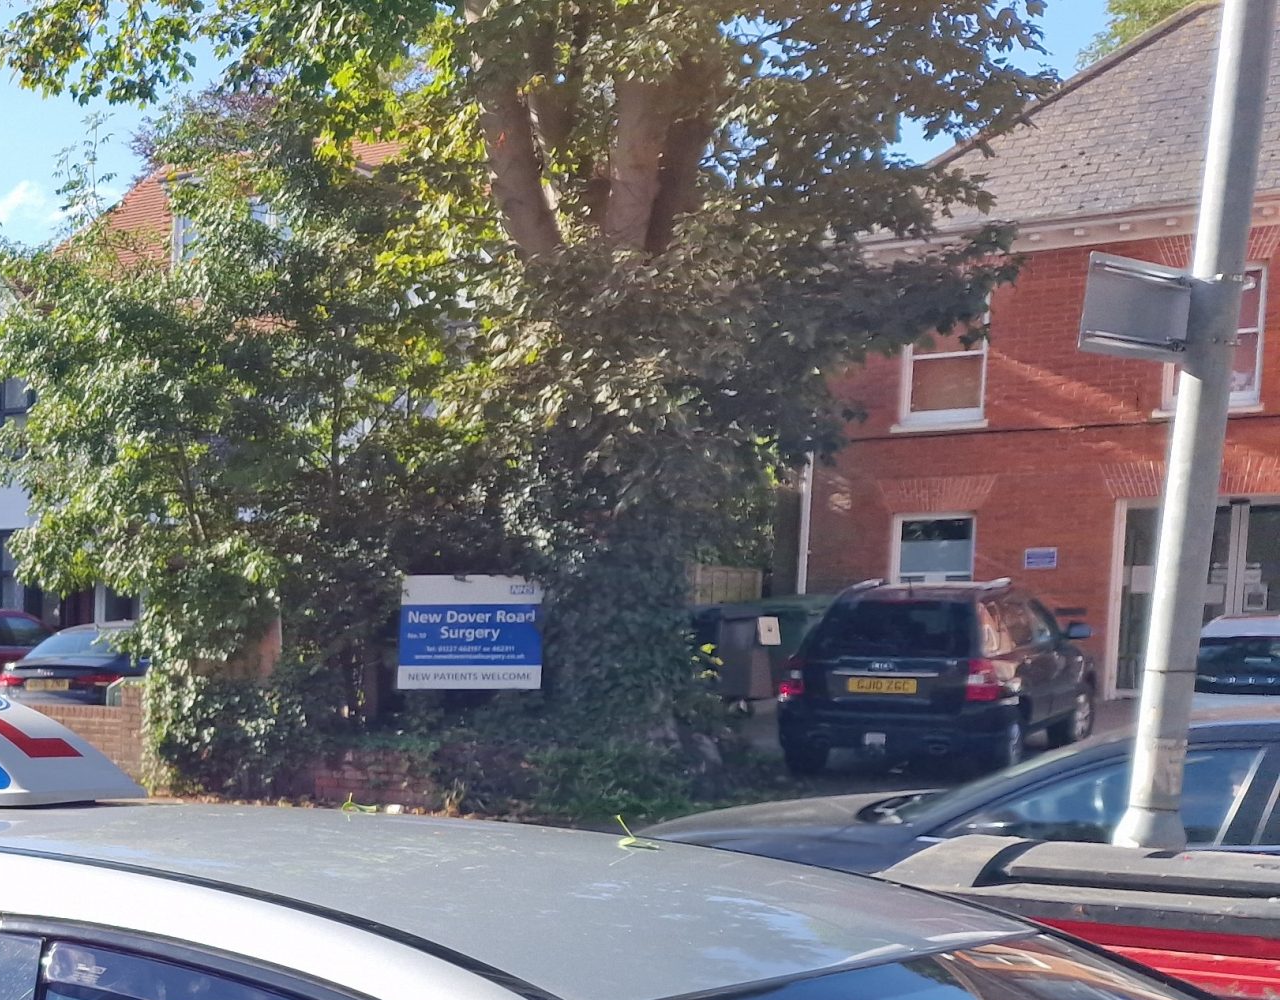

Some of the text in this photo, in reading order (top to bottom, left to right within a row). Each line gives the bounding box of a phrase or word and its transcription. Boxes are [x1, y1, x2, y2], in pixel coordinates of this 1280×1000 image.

[408, 609, 536, 624] New Dover Road
[440, 626, 500, 642] Surgery
[408, 671, 532, 681] NEW PATIENTS WELCOME
